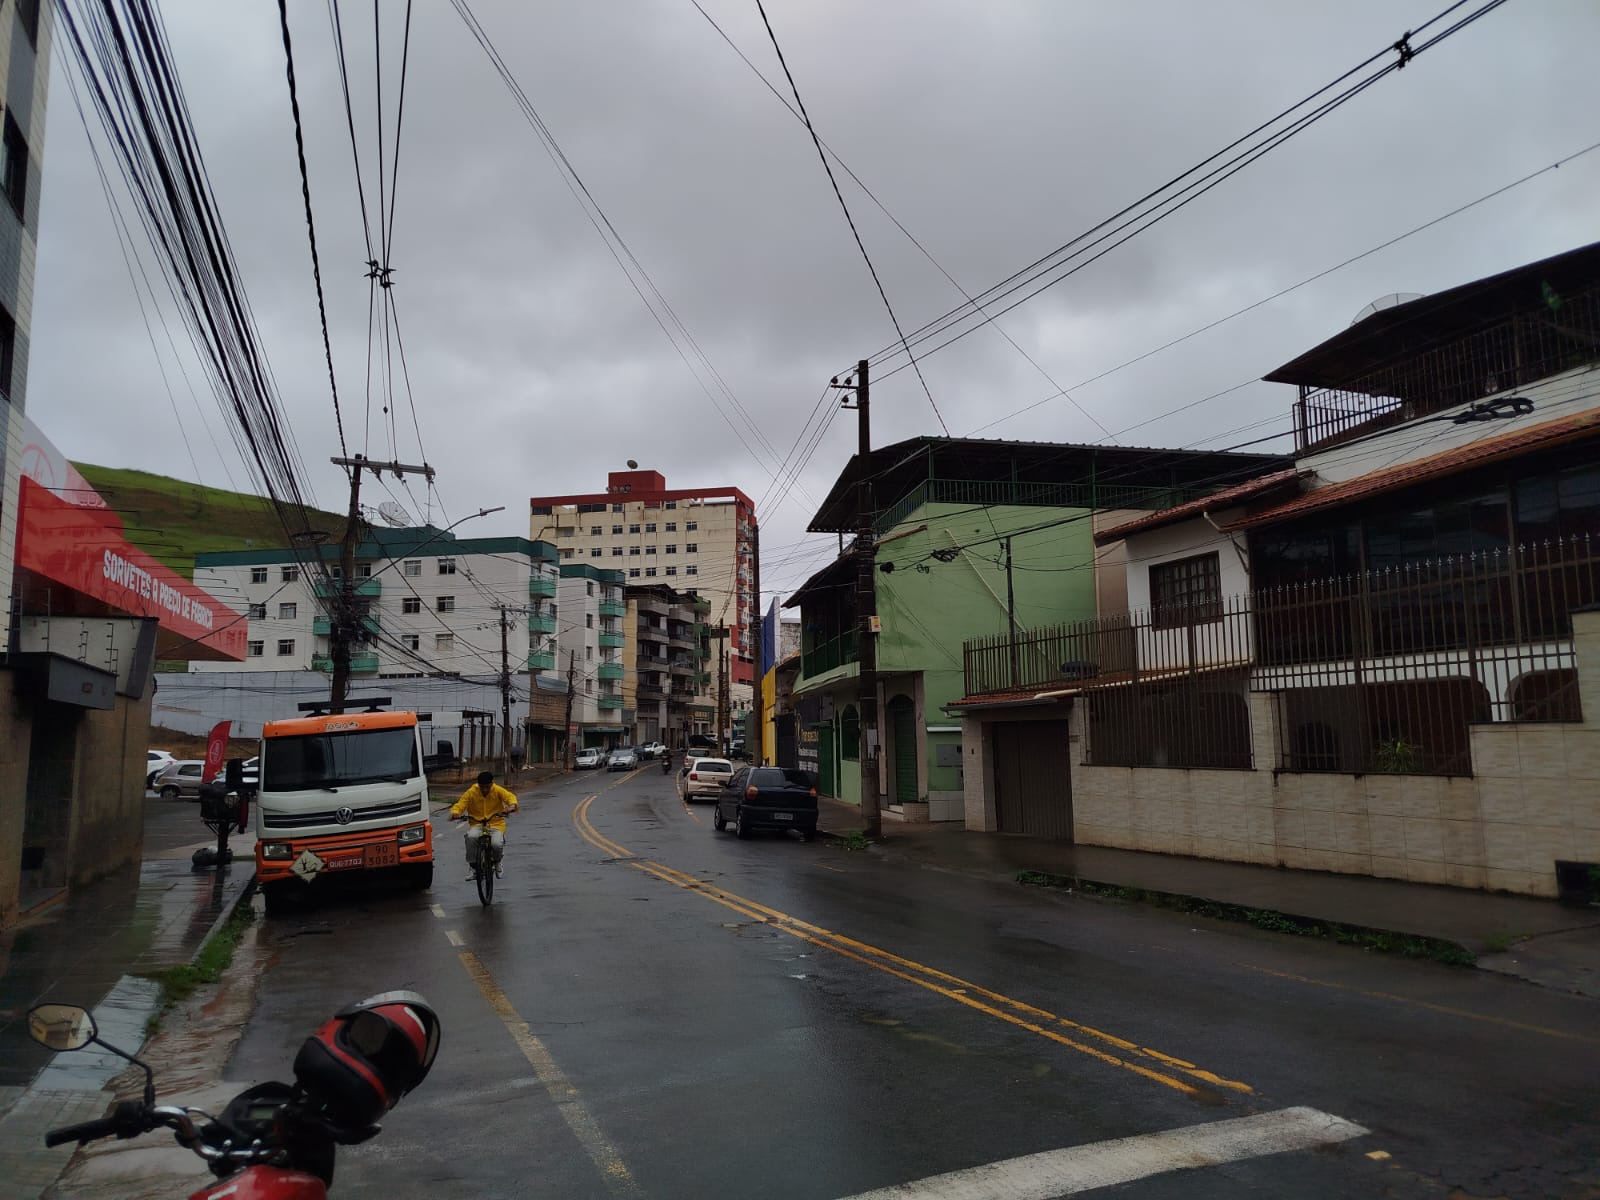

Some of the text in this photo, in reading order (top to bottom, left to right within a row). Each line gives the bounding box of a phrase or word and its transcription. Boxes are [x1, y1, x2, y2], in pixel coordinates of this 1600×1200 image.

[103, 549, 213, 630] SORVETES A PREÇO DE FÁBRICA
[375, 845, 388, 854] 90
